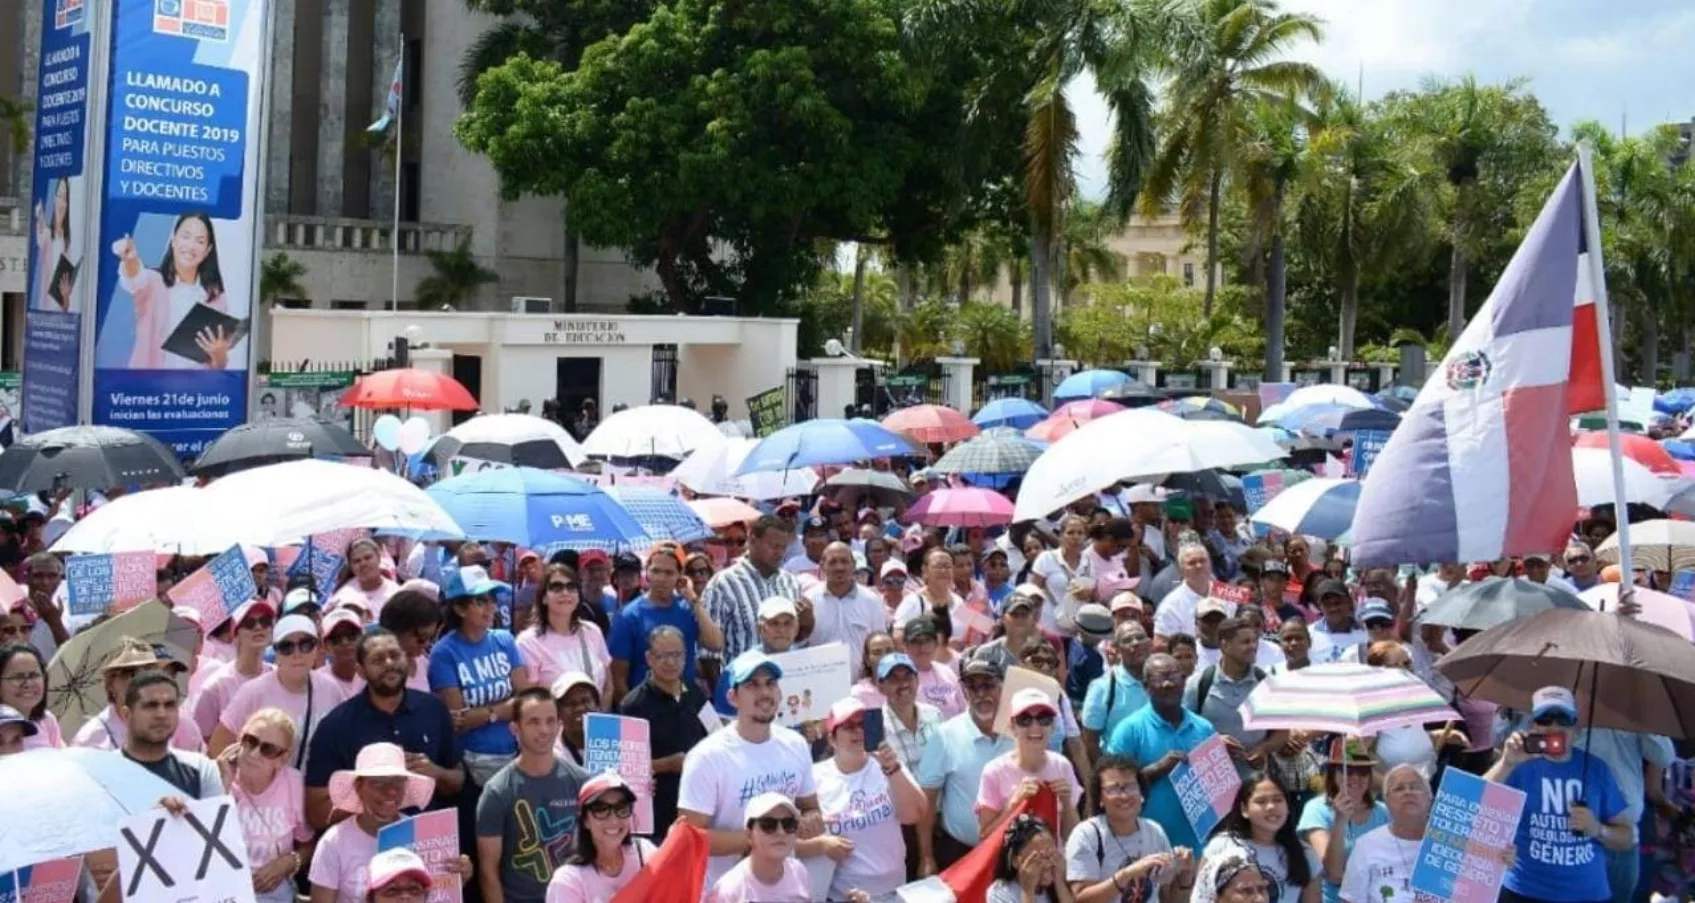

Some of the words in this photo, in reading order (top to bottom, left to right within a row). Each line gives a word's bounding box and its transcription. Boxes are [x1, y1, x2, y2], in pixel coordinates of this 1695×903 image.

[127, 71, 207, 95] LLAMADO
[209, 83, 220, 98] A
[125, 93, 214, 117] CONCURSO
[124, 115, 199, 138] DOCENTE
[202, 125, 240, 143] 2019
[122, 137, 159, 155] PARA
[162, 141, 226, 162] PUESTOS
[121, 158, 205, 180] DIRECTIVOS
[120, 180, 130, 194] Y
[133, 181, 208, 201] DOCENTES
[553, 319, 618, 332] MINISTERIO
[543, 332, 558, 343] DE
[110, 393, 160, 406] Viernes
[195, 391, 230, 408] junio
[110, 410, 145, 420] inician
[147, 410, 161, 420] las
[163, 410, 229, 419] evaluaciones
[457, 662, 476, 687] A
[473, 651, 511, 683] MIS
[589, 739, 609, 750] LOS
[1438, 790, 1467, 807] PARA
[1541, 777, 1583, 815] NO
[1435, 802, 1501, 835] RESPETO
[1424, 853, 1443, 868] DE
